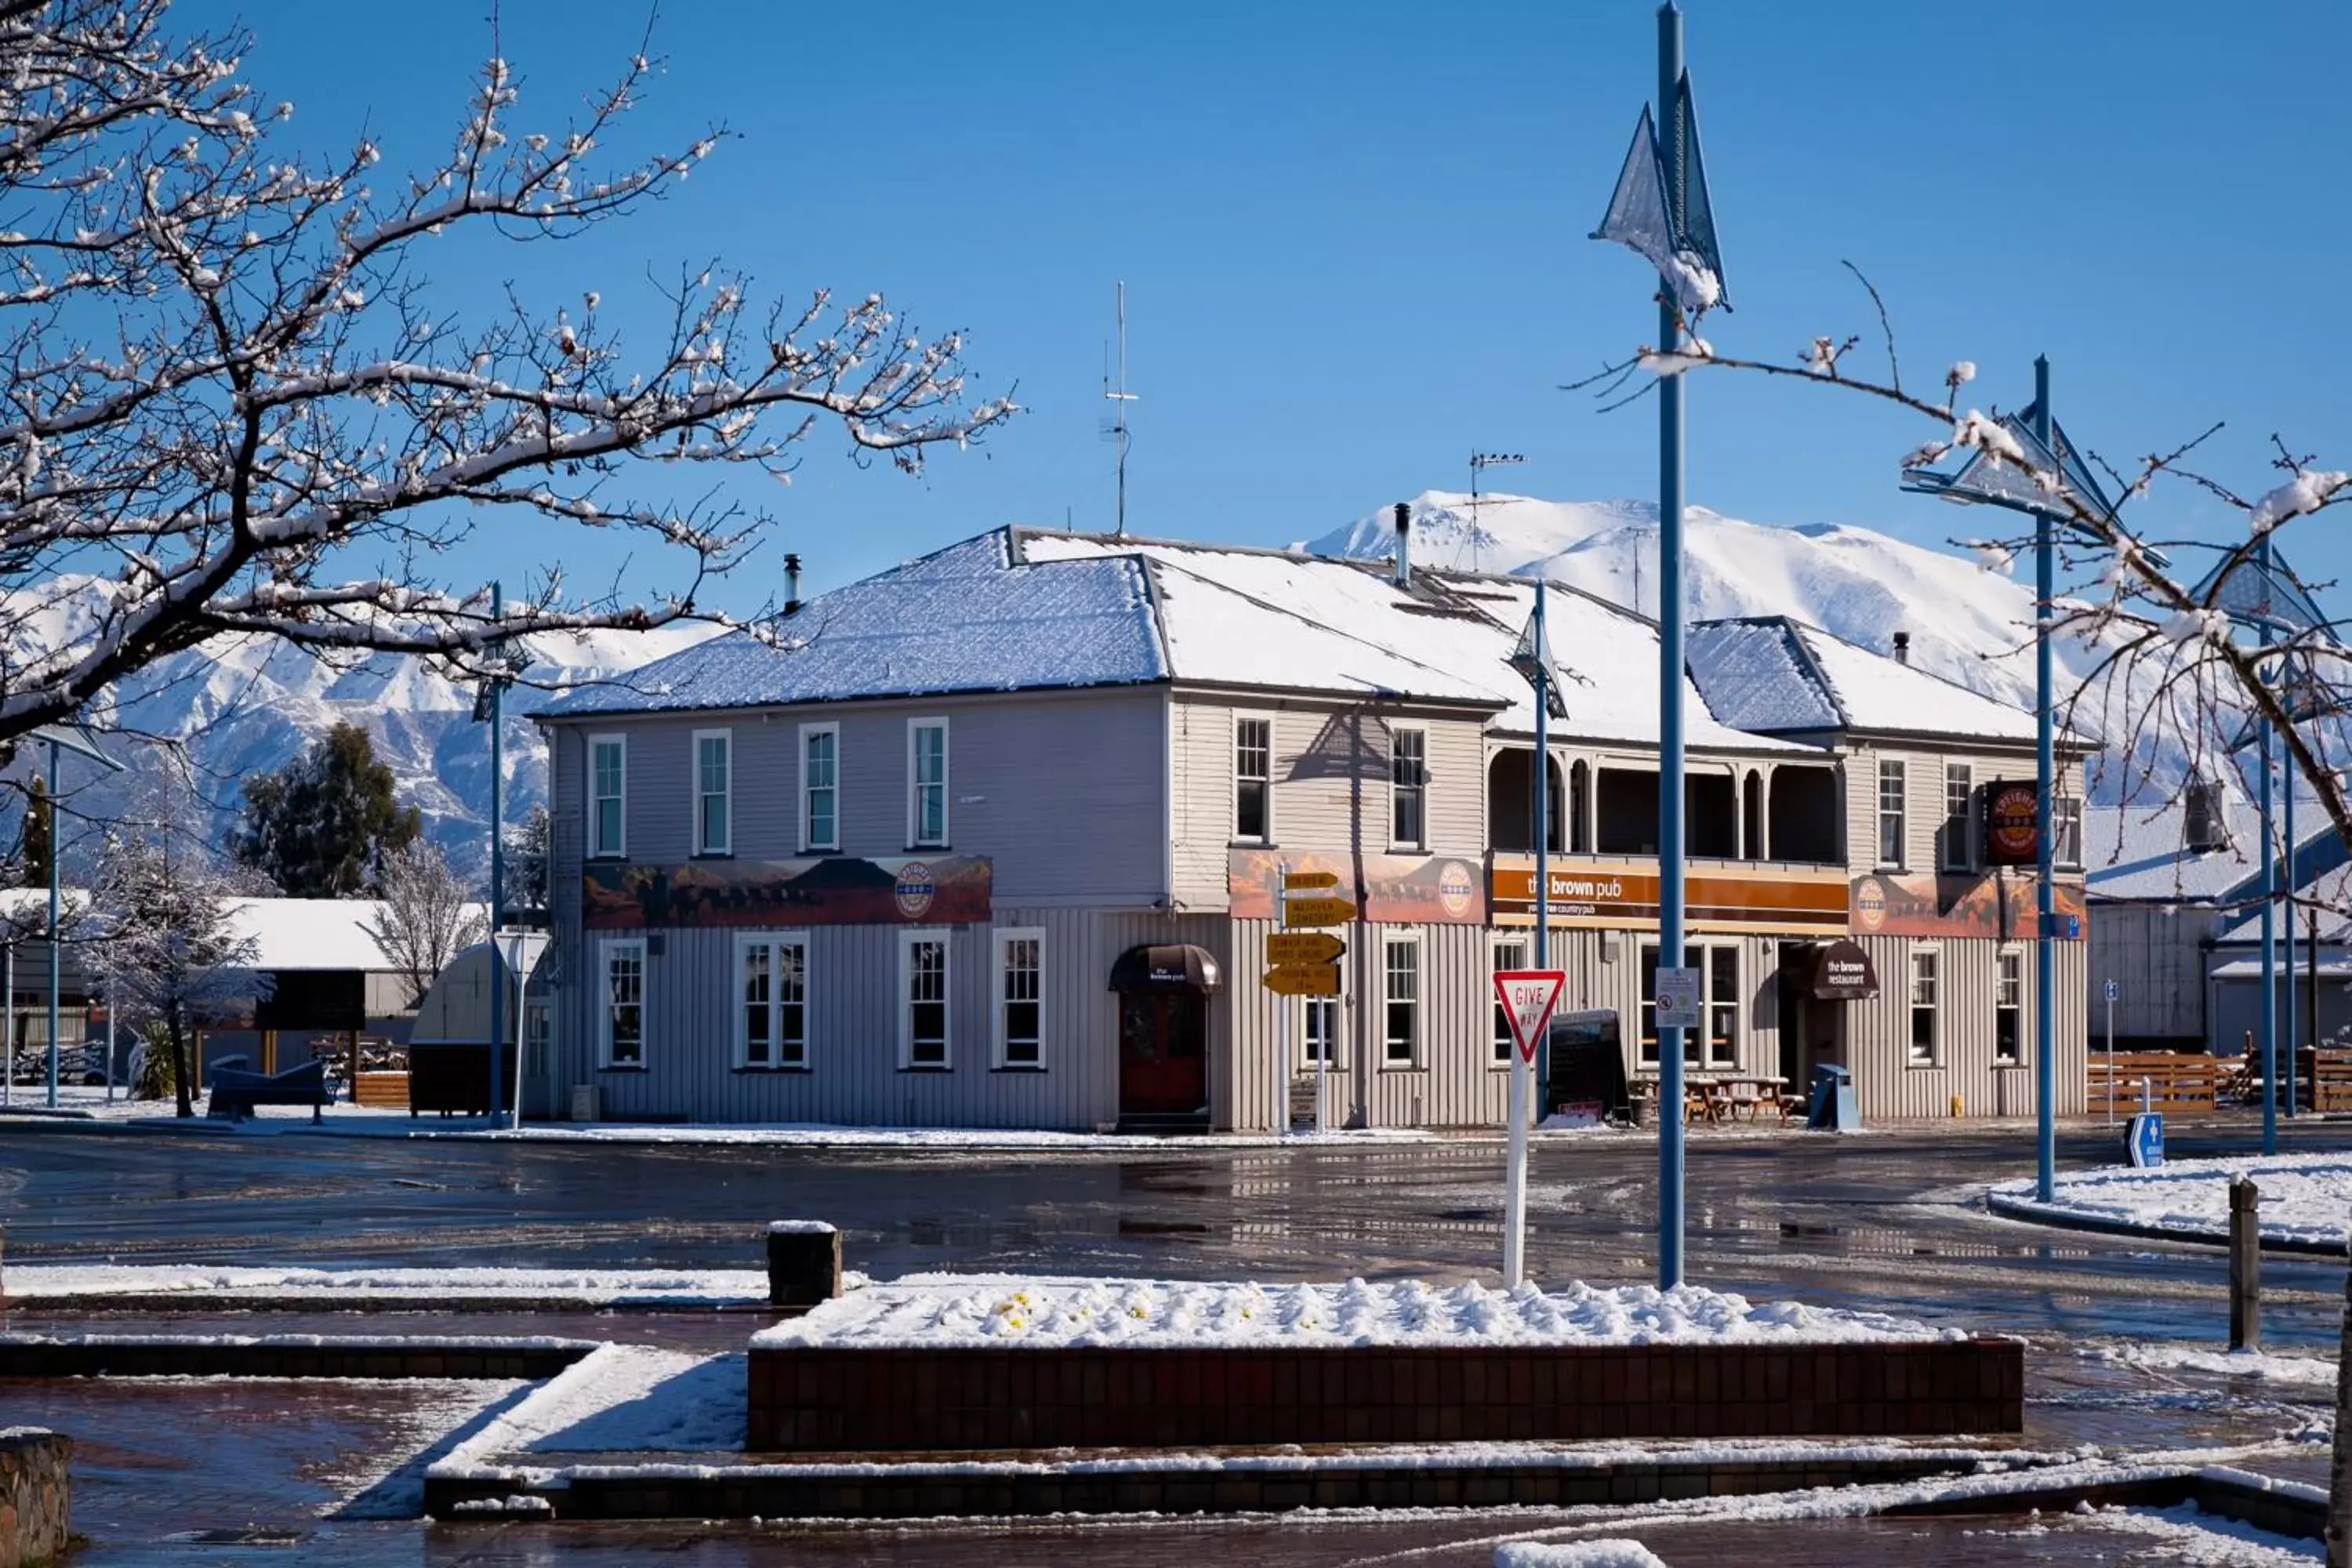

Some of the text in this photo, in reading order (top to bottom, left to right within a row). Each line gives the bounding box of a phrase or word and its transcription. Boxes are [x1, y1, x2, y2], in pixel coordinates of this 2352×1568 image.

[1552, 876, 1594, 895] brown
[1597, 878, 1622, 901] pub
[1828, 960, 1865, 973] the brown
[1828, 974, 1864, 985] restaurant
[1516, 986, 1544, 1005] GIVE
[1520, 1011, 1537, 1028] WAY
